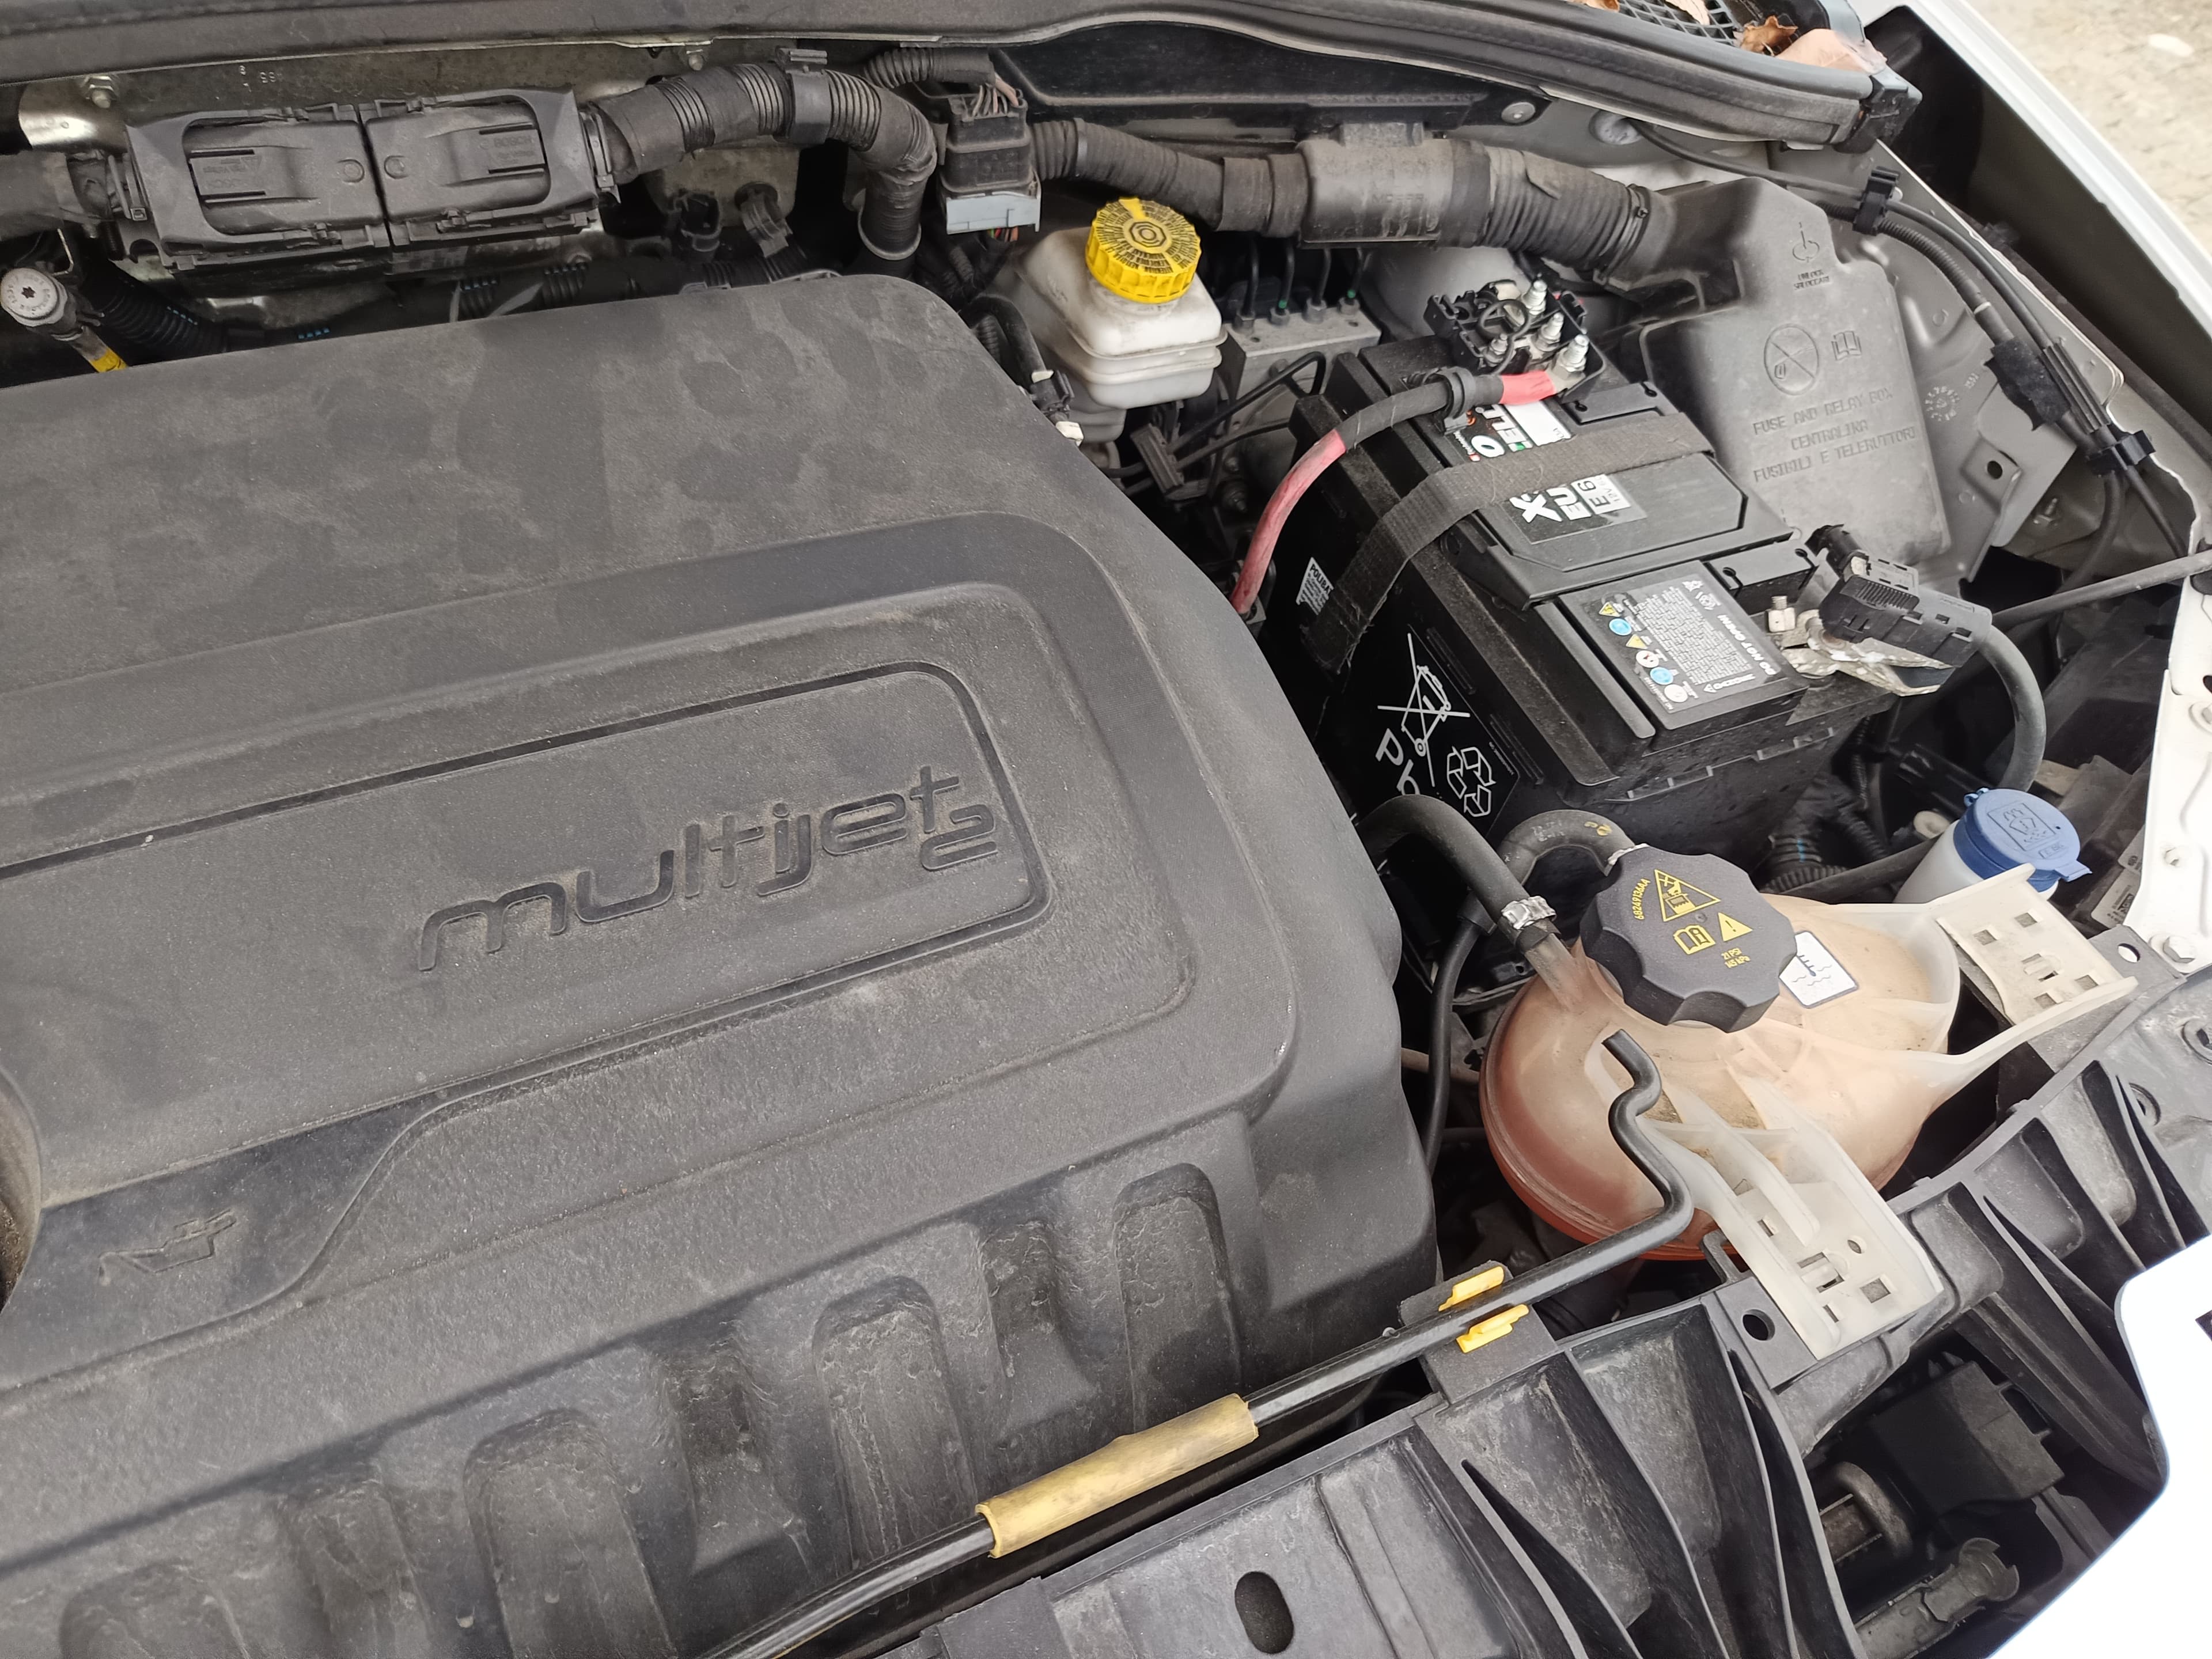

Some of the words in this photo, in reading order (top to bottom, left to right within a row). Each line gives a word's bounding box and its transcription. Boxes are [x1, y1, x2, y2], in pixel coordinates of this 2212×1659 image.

[1752, 415, 1786, 435] FUSE
[1793, 407, 1817, 425] AND
[1824, 396, 1865, 416] RELAY
[1869, 388, 1893, 404] BOX
[1753, 456, 1812, 483] FUSIBILI
[1820, 450, 1830, 464] E
[1834, 426, 1916, 460] TELERUTTORI
